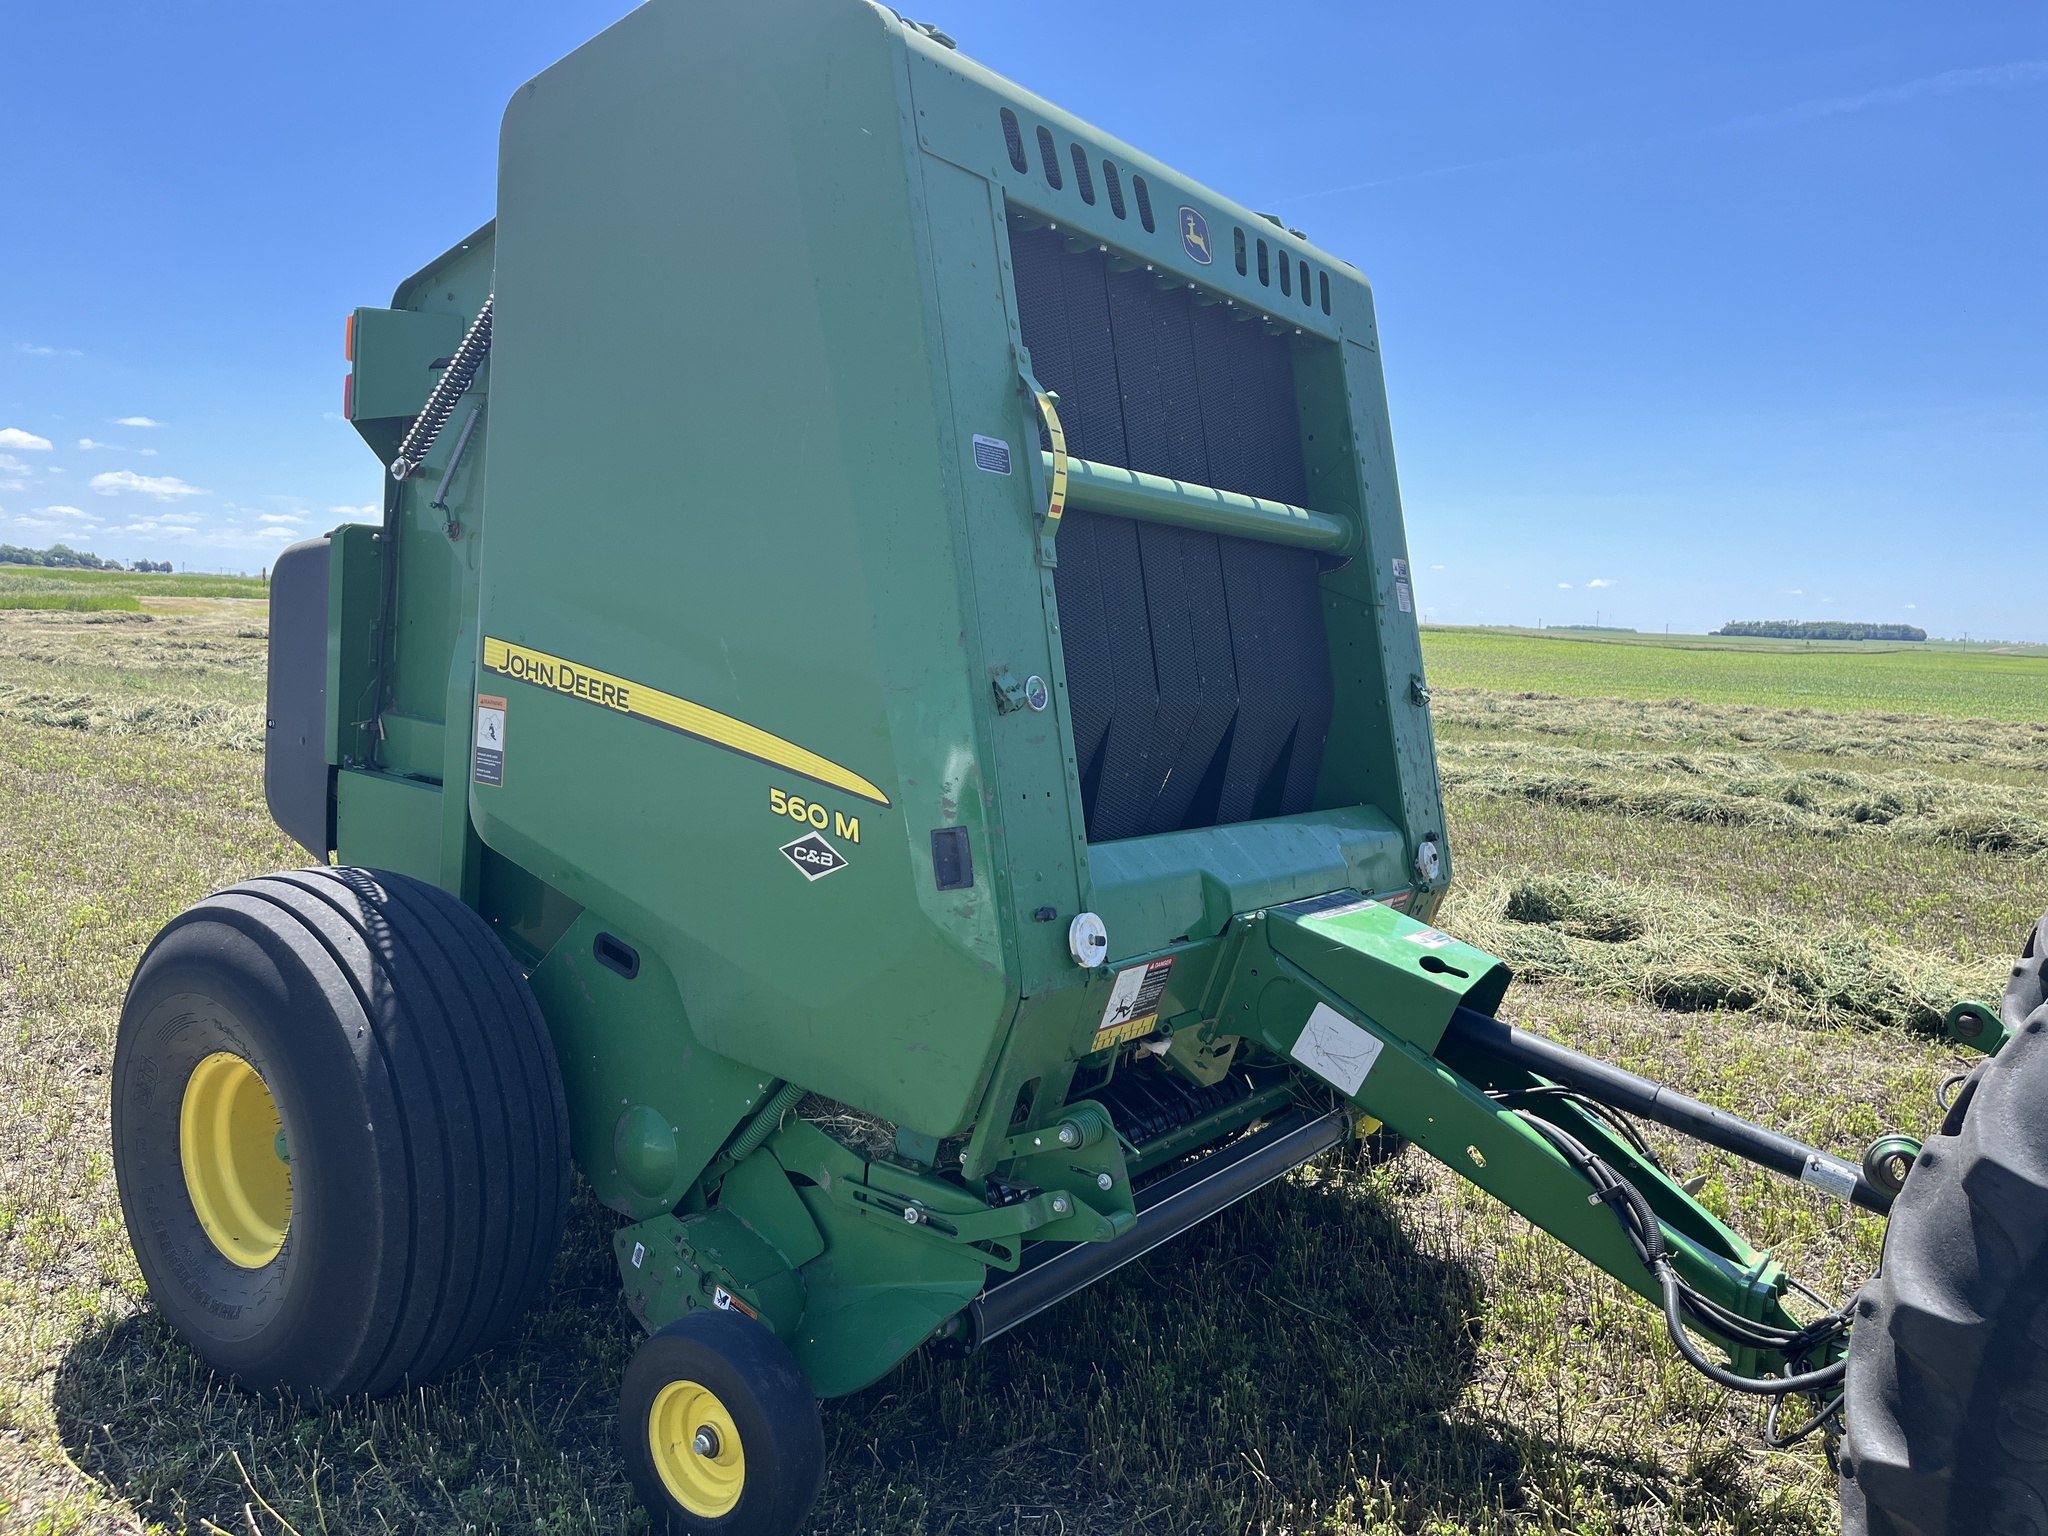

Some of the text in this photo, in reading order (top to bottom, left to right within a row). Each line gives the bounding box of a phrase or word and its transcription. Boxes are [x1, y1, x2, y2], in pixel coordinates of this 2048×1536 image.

[498, 648, 630, 709] JOHN DEERE
[770, 787, 860, 844] 560 M
[793, 846, 833, 866] C&B
[1154, 958, 1173, 969] DANGER
